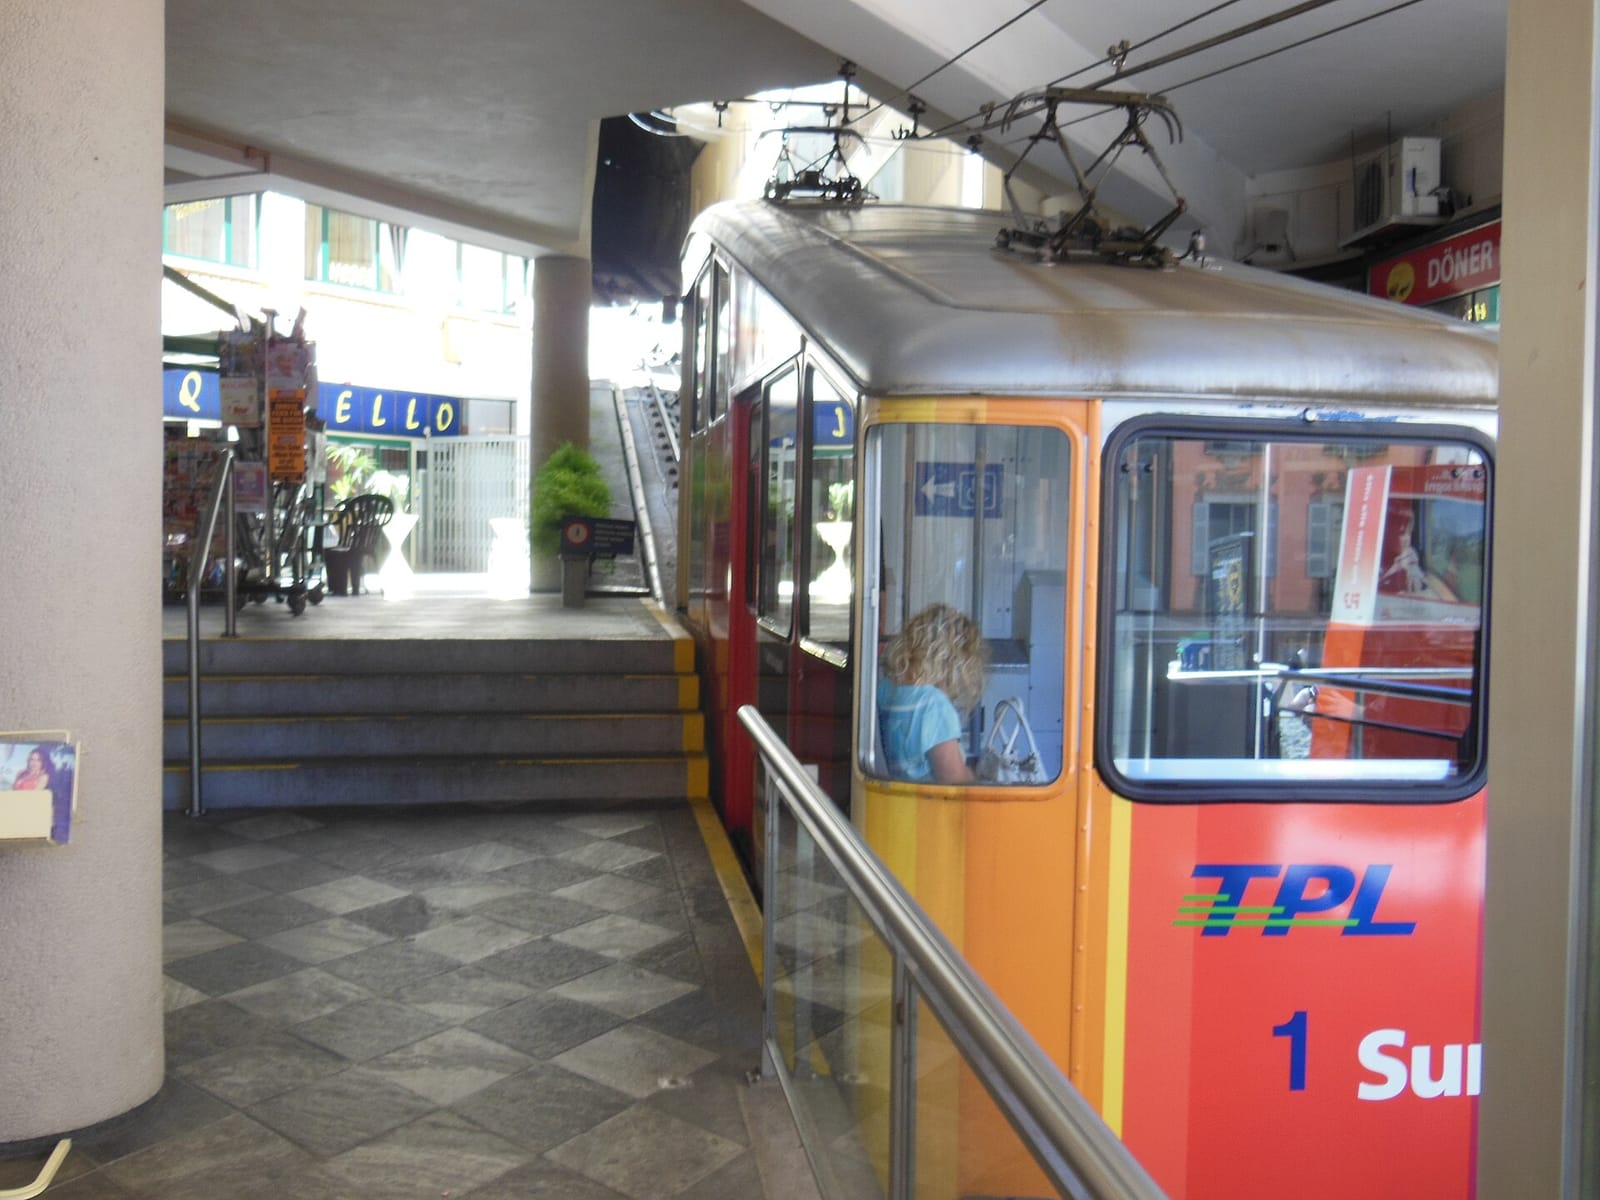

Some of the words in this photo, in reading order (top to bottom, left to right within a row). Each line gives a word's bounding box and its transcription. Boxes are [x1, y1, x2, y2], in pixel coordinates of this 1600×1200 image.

[1427, 239, 1492, 288] DÖNER
[1191, 864, 1417, 936] TPL
[1272, 1010, 1308, 1091] 1
